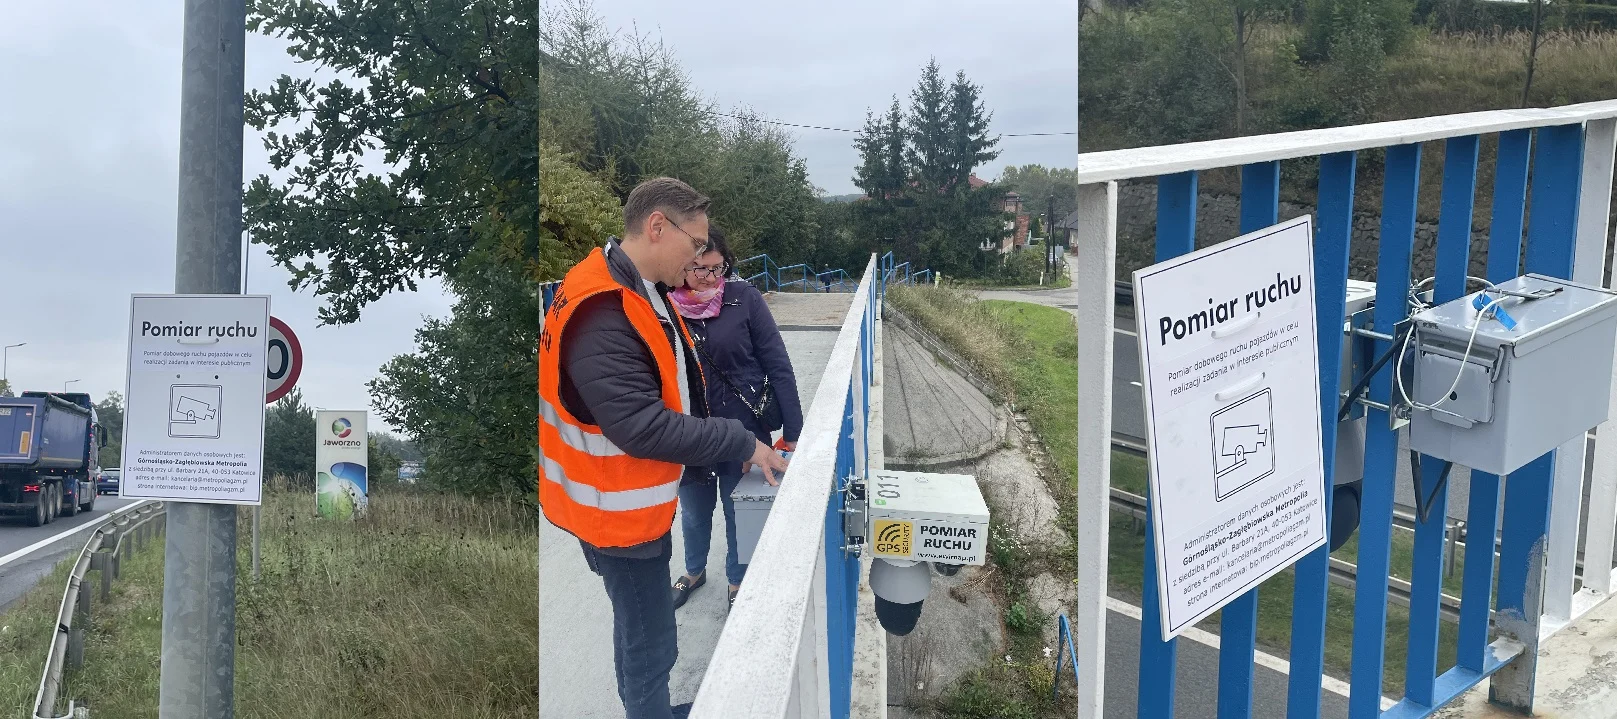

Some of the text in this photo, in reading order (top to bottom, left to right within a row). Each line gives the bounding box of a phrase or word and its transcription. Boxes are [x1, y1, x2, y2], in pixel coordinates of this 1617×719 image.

[142, 320, 257, 338] Pomiar ruchu
[1159, 272, 1301, 346] Pomiar ruchu
[267, 339, 289, 379] 0
[1168, 365, 1192, 381] Pomiar
[1194, 351, 1228, 371] dobowego
[1229, 343, 1248, 355] ruchu
[1249, 329, 1278, 349] pojazdów
[1286, 321, 1299, 332] celu
[1170, 377, 1201, 396] realizacji
[1203, 366, 1228, 383] zadania
[1237, 350, 1264, 367] interesie
[1265, 335, 1299, 357] publicznym
[323, 439, 361, 447] Jaworzno
[902, 523, 910, 554] SECURITY
[920, 525, 977, 539] POMIAR
[923, 538, 972, 551] RUCHU
[1178, 563, 1205, 584] siedzibą
[1206, 550, 1220, 569] przy
[1221, 548, 1229, 558] ul.
[1231, 534, 1255, 553] Barbary
[1257, 525, 1269, 538] 21A,
[1271, 511, 1292, 529] 40-053
[1293, 498, 1318, 523] Katowice
[1183, 490, 1308, 566] Górnośląsko-Zagłębiowska Metropolia
[1184, 479, 1305, 551] Administratorem danych osobowych jest:
[876, 543, 901, 553] GPS
[1183, 513, 1311, 595] adres e-mail: kancelaria@metropoliagzm.pl
[1187, 528, 1308, 607] strona internetowa: bip.metropoliagzm.pl
